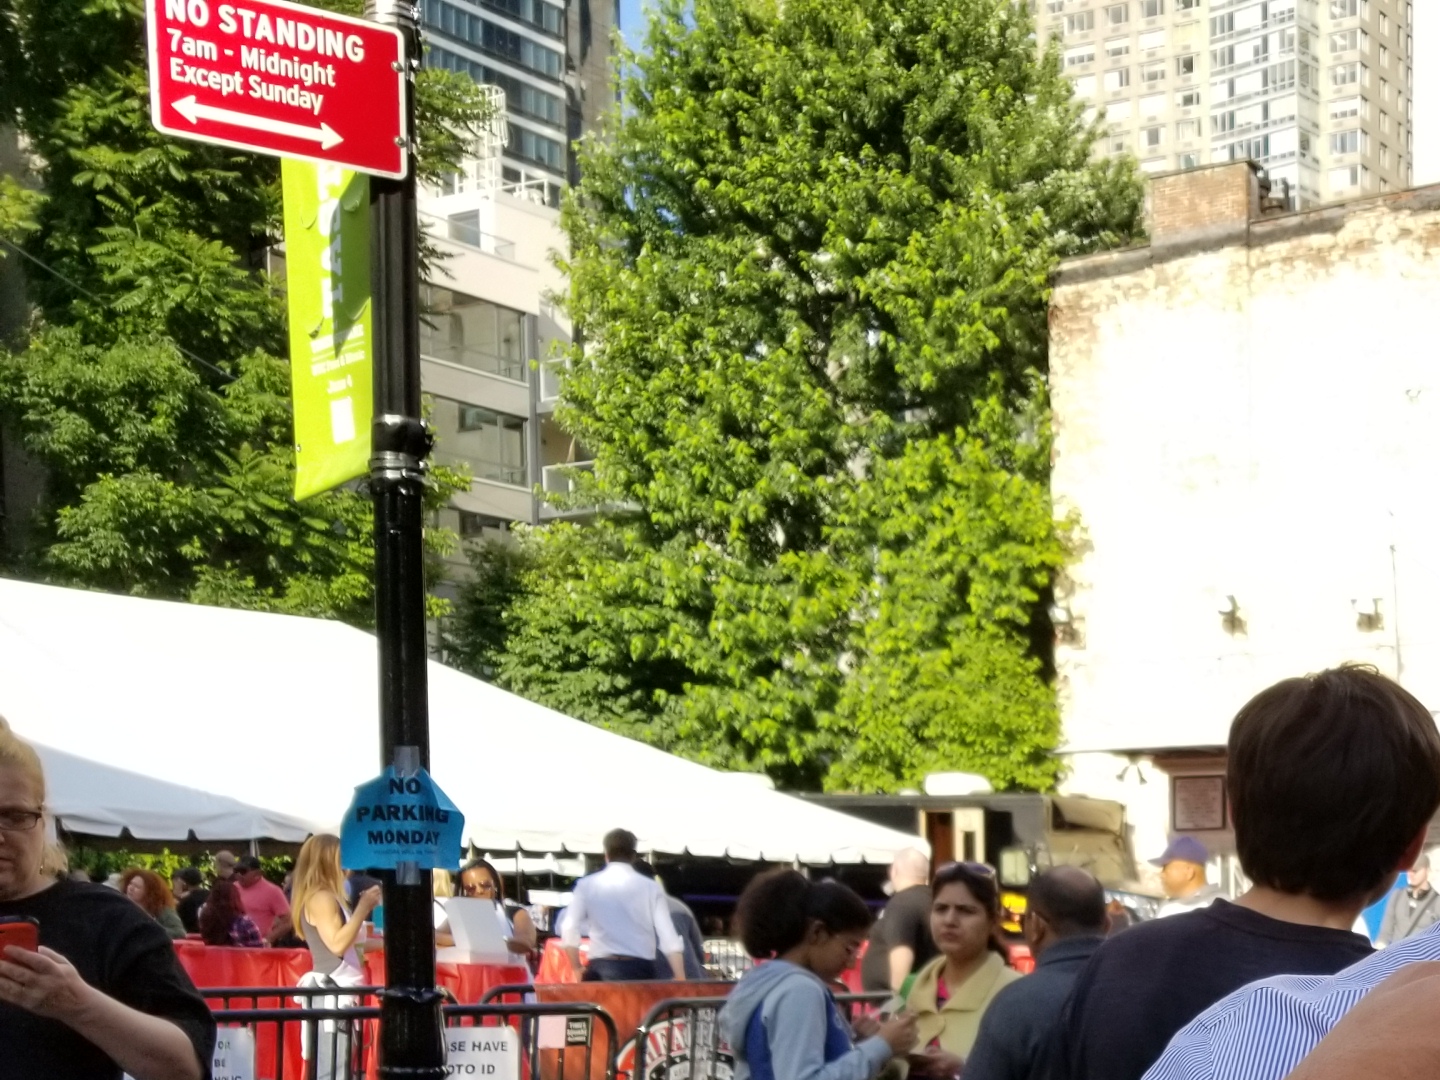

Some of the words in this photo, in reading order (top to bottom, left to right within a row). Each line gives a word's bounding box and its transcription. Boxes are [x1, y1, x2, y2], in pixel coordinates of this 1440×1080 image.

[165, 0, 209, 27] NO
[218, 4, 365, 63] STANDING
[166, 27, 218, 61] 7am
[240, 45, 336, 88] Midnight
[169, 57, 244, 96] Except
[248, 75, 324, 116] Sunday
[389, 777, 422, 795] NO
[356, 804, 450, 824] PARKING
[367, 830, 441, 845] MONDAY
[471, 1041, 508, 1052] HAVE
[448, 1064, 475, 1074] OTO
[481, 1064, 495, 1074] ID
